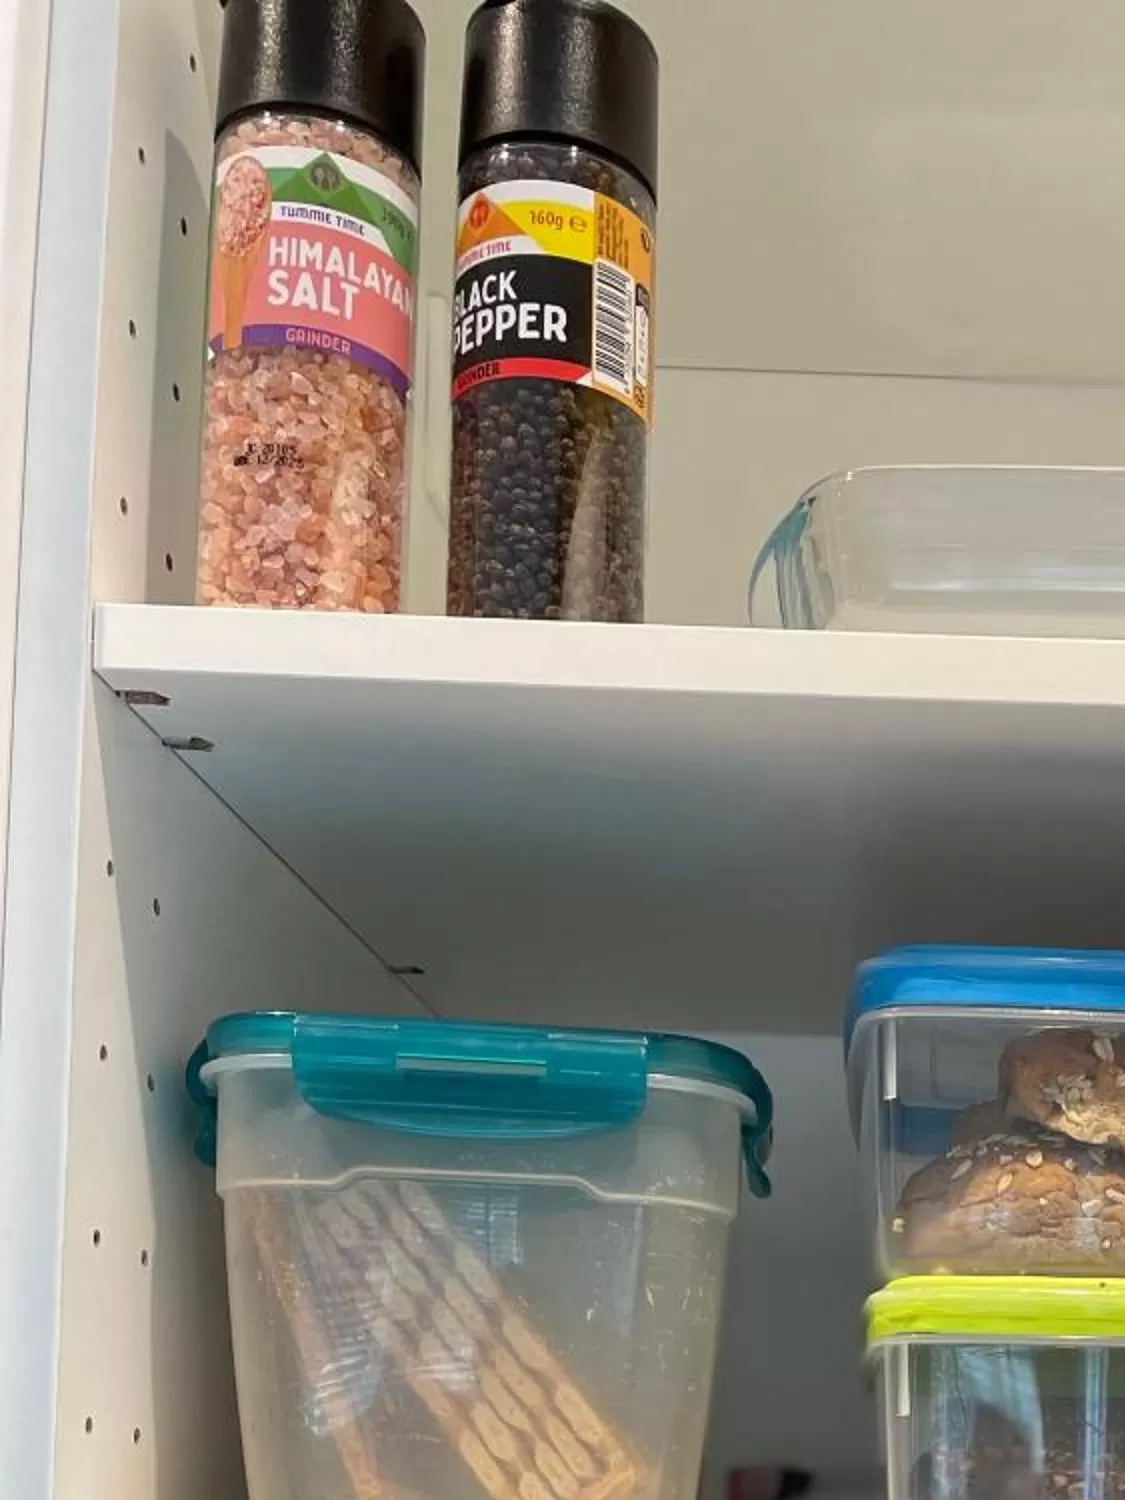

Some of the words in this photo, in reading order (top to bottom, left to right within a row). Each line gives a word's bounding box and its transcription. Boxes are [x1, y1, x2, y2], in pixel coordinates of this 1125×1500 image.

[280, 205, 331, 225] TUMMIE
[336, 215, 365, 236] TIME
[529, 210, 563, 230] 160g
[267, 269, 360, 321] SALT
[268, 236, 413, 321] HIMALAYAN
[285, 327, 351, 353] GRINDER
[454, 302, 567, 355] PEPPER
